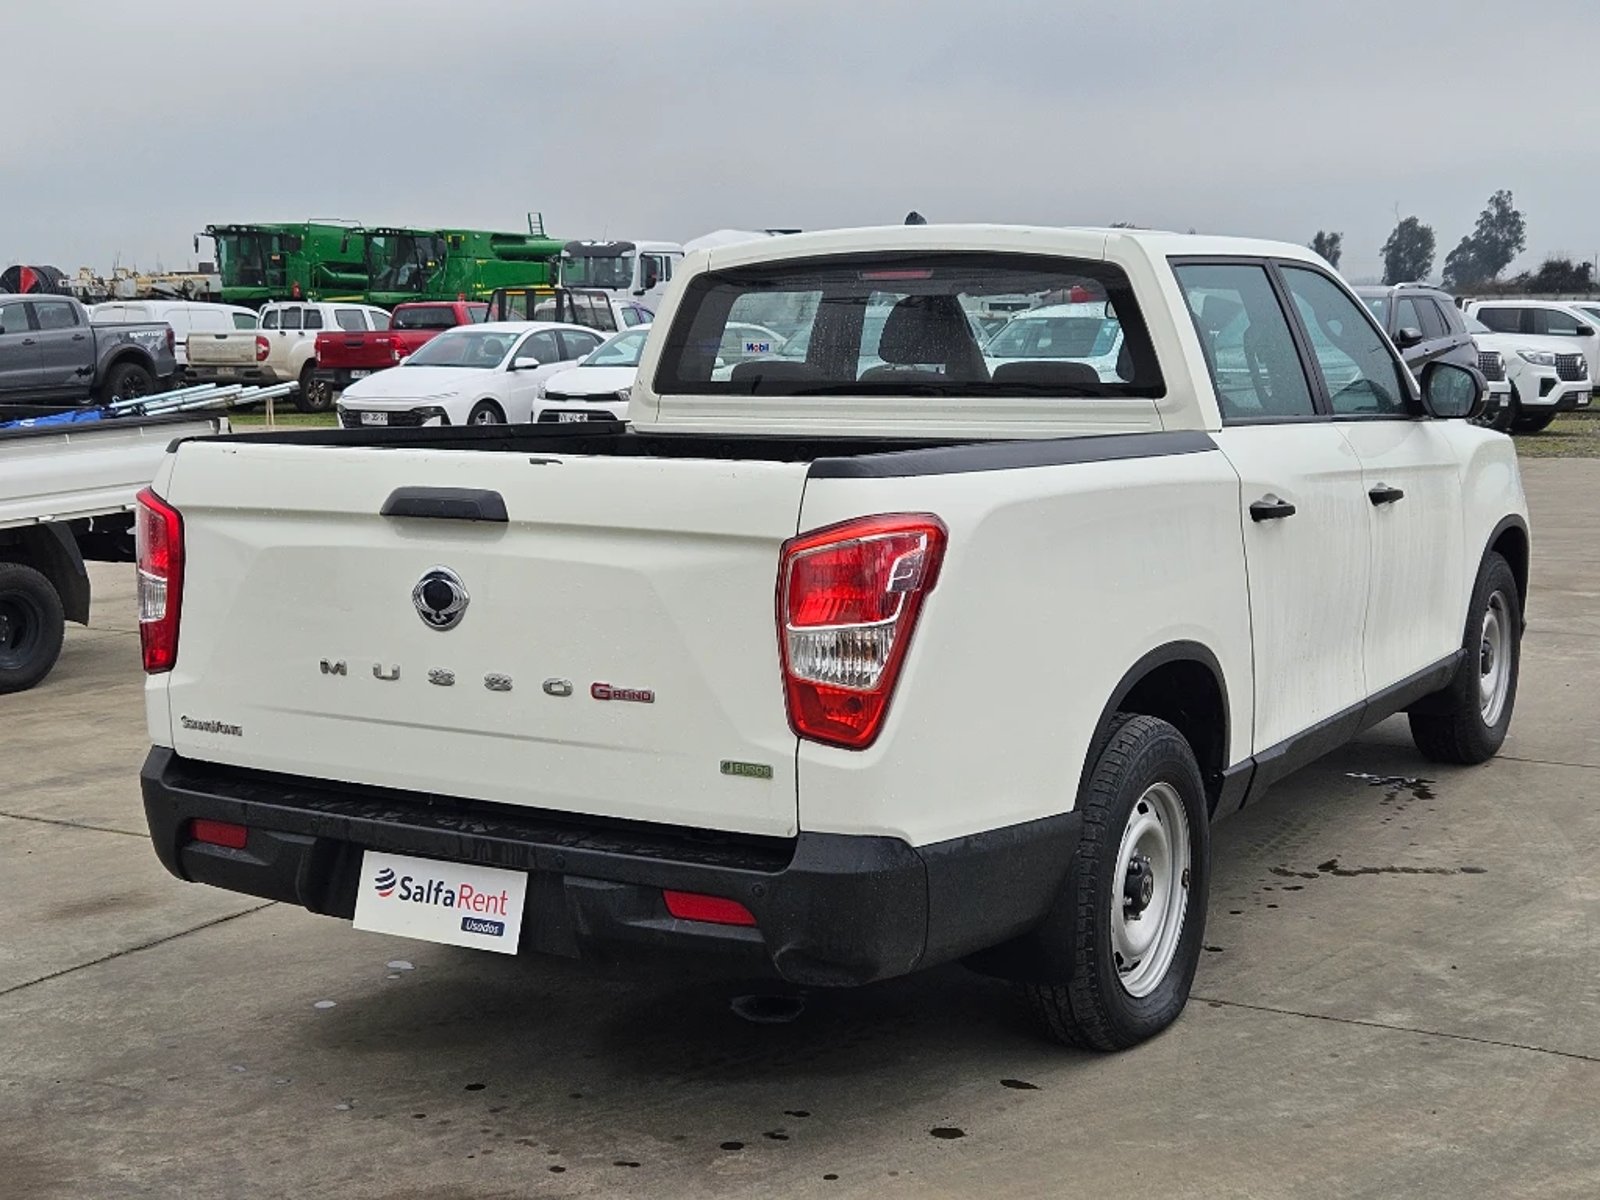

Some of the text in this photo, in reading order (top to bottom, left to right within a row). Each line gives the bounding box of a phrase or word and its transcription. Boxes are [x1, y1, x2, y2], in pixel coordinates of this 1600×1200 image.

[746, 343, 770, 353] Mobil
[319, 657, 656, 703] MUSSO GRAND
[398, 876, 508, 916] SalfaRent
[465, 919, 500, 935] Usados
